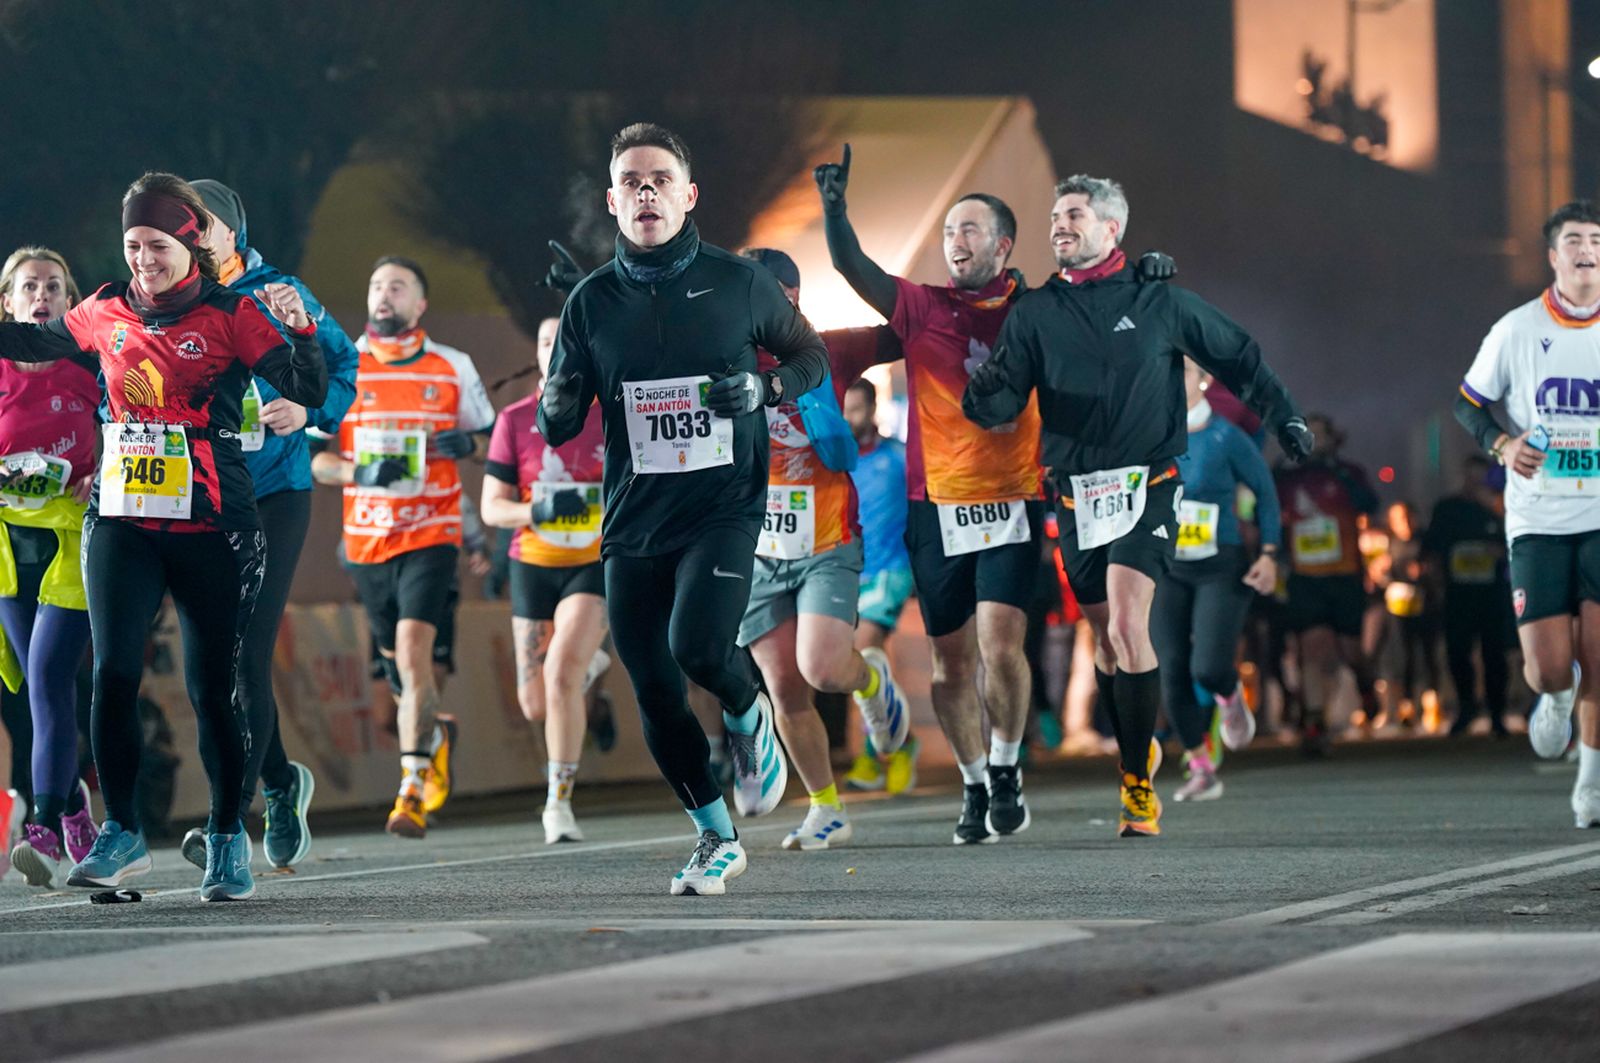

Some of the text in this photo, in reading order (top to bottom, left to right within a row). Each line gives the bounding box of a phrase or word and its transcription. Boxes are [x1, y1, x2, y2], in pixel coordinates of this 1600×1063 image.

[636, 398, 691, 413] SAN ANTÓN
[646, 390, 677, 401] NOCHE
[679, 388, 690, 398] DE
[646, 410, 712, 442] 7033
[145, 434, 157, 443] DE
[122, 457, 165, 486] 646
[1557, 448, 1600, 471] 7851
[955, 501, 1012, 527] 6680
[1093, 492, 1133, 520] 6681
